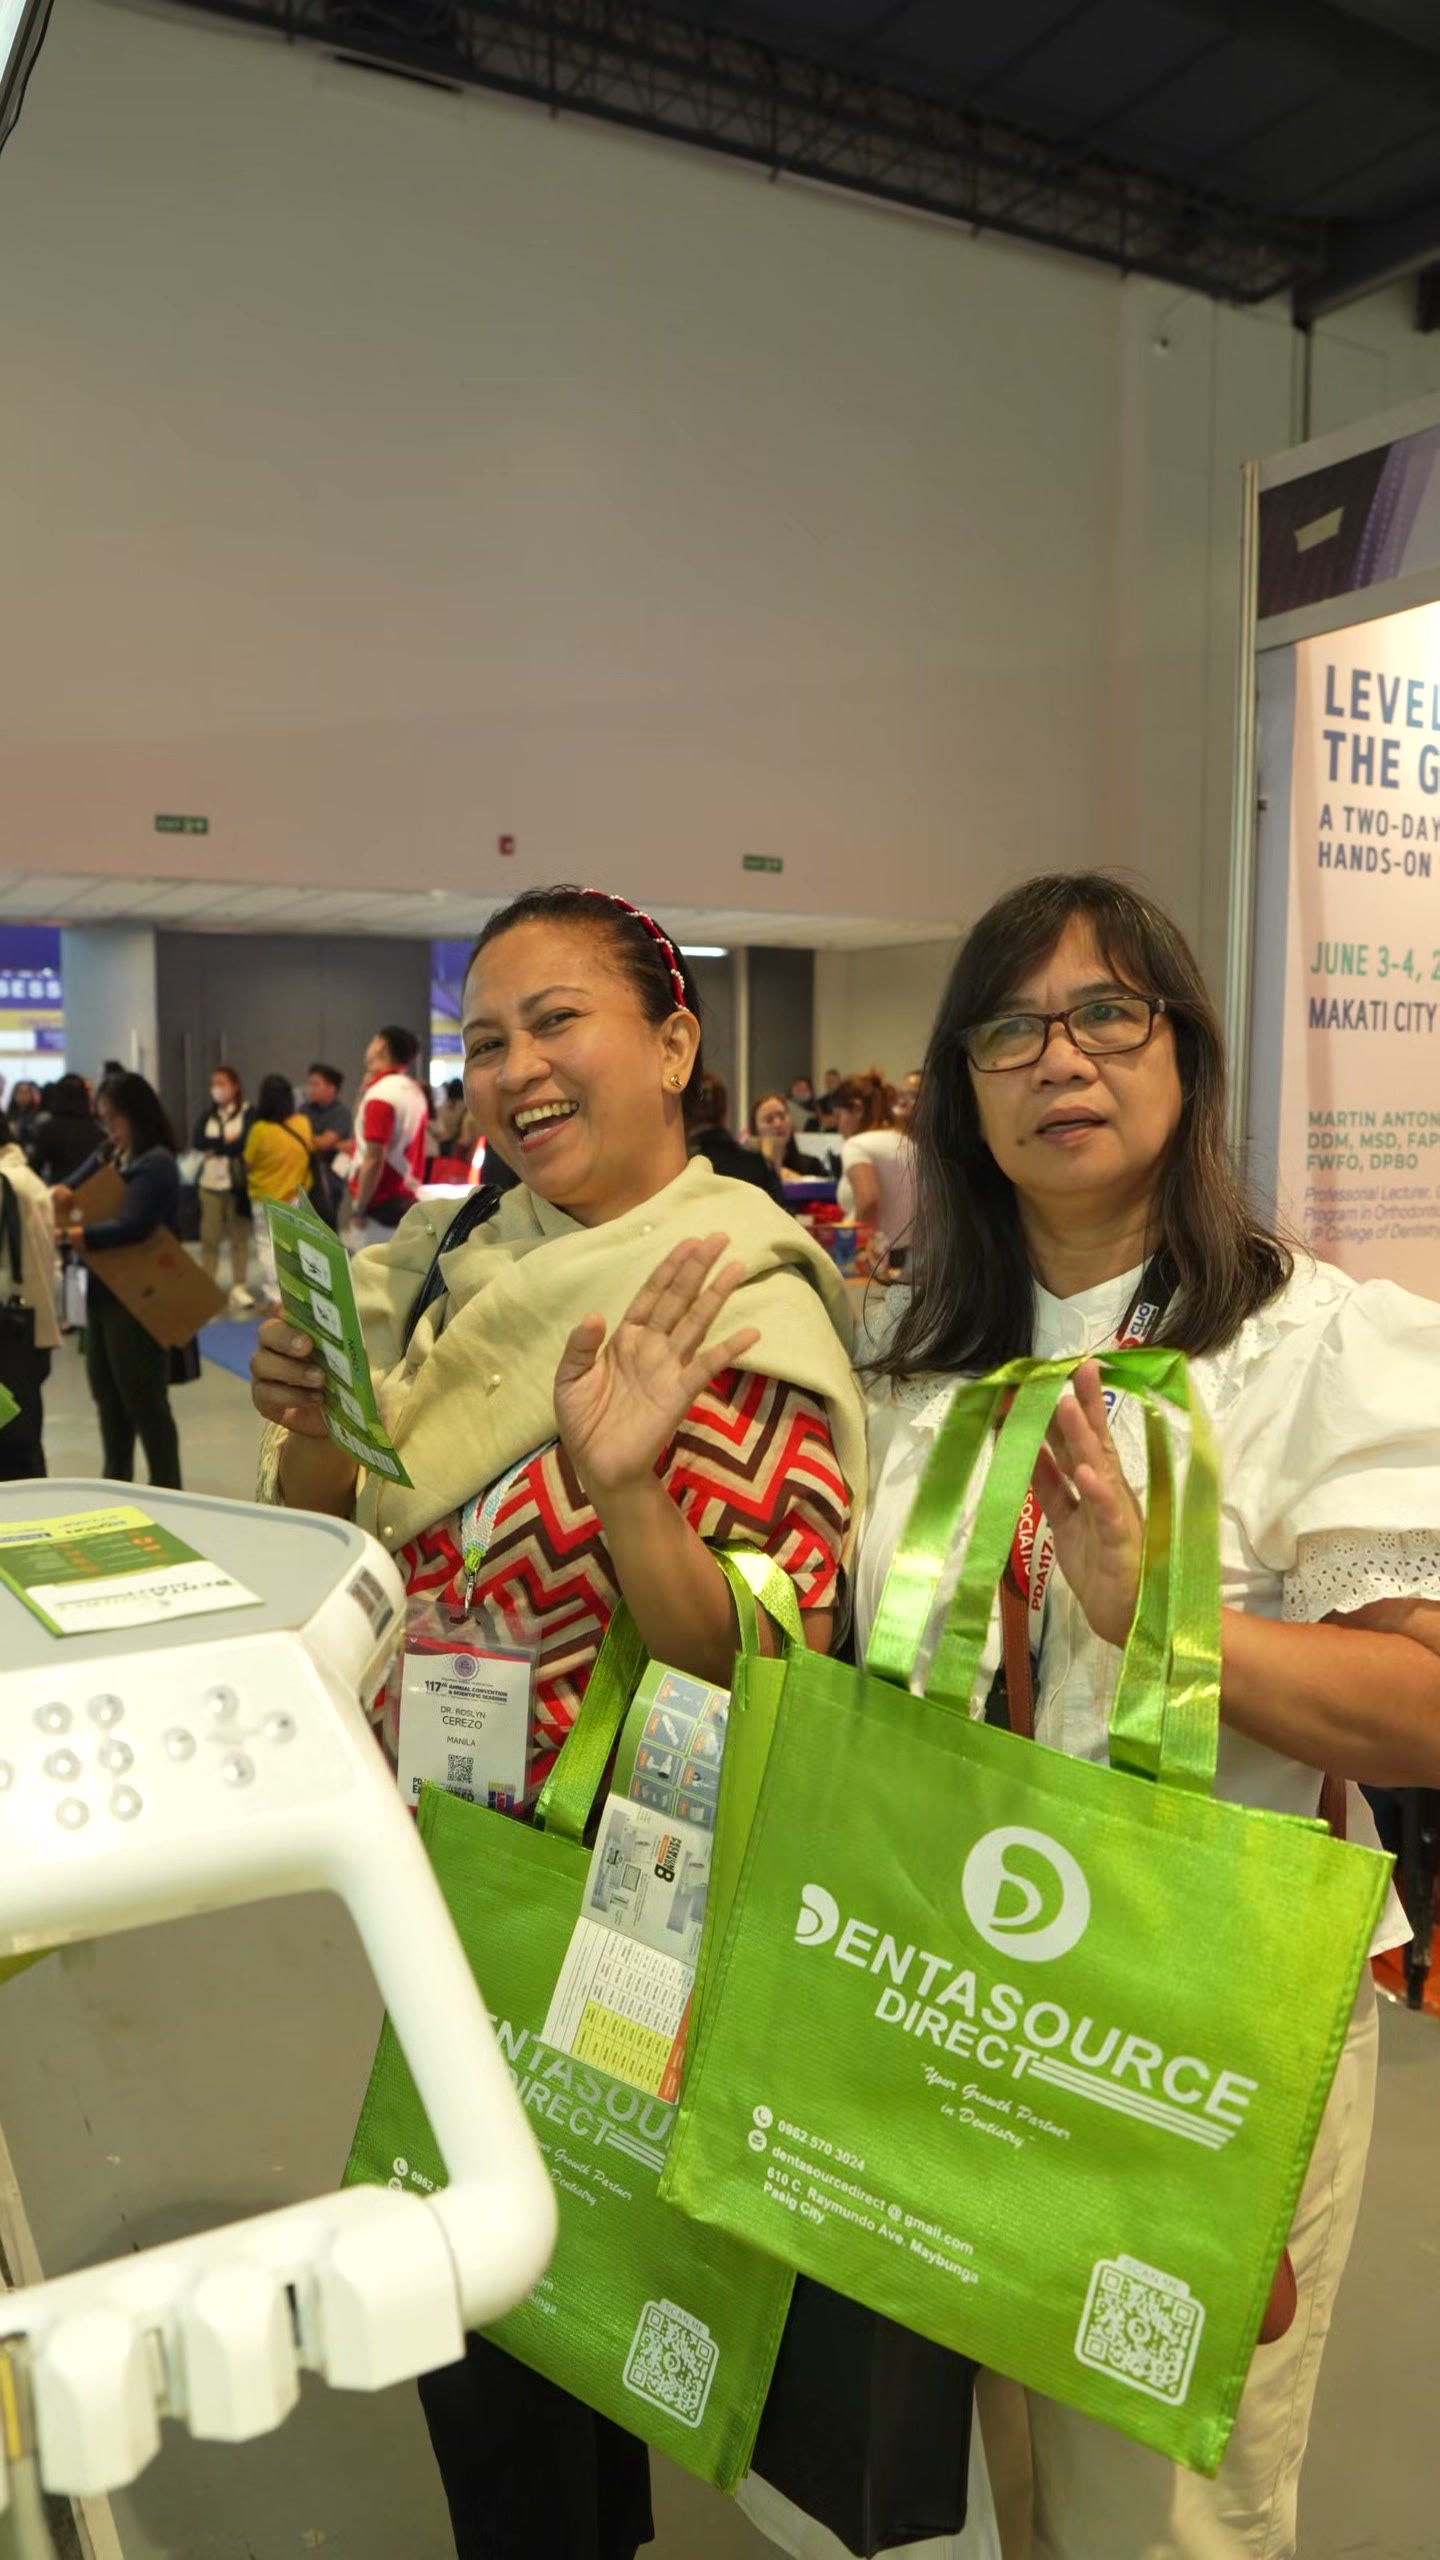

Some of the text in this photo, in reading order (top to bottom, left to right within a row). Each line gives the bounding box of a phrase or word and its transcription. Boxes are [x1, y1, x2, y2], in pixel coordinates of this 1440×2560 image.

[1323, 729, 1401, 789] THE
[1319, 803, 1440, 843] A TWO-DAY
[1318, 841, 1431, 878] HANDS-ON
[1310, 941, 1369, 975] JUNE
[1377, 945, 1422, 983] 3-4,
[1309, 997, 1438, 1032] MAKATI CITY
[1308, 1111, 1376, 1127] MARTIN
[1308, 1132, 1354, 1151] DDM,
[1360, 1132, 1402, 1150] MSD,
[1306, 1153, 1418, 1173] FWFO, DPBO
[442, 1715, 483, 1730] CEREZO
[455, 1708, 486, 1719] ROSLYN
[447, 1735, 476, 1747] MANILA
[794, 1883, 1259, 2126] DENTASOURCE
[874, 1988, 1042, 2080] DIRECT
[962, 2084, 1013, 2114] Growth
[1016, 2105, 1071, 2140] Partner
[778, 2119, 866, 2172] 0962 570 3024
[592, 2169, 632, 2201] Partner
[763, 2182, 826, 2226] Pasig City
[771, 2146, 974, 2256] dentasourcedirect @ gmail.com
[767, 2166, 790, 2186] 610
[807, 2186, 876, 2231] Raymundo
[910, 2238, 979, 2284] Maybunga
